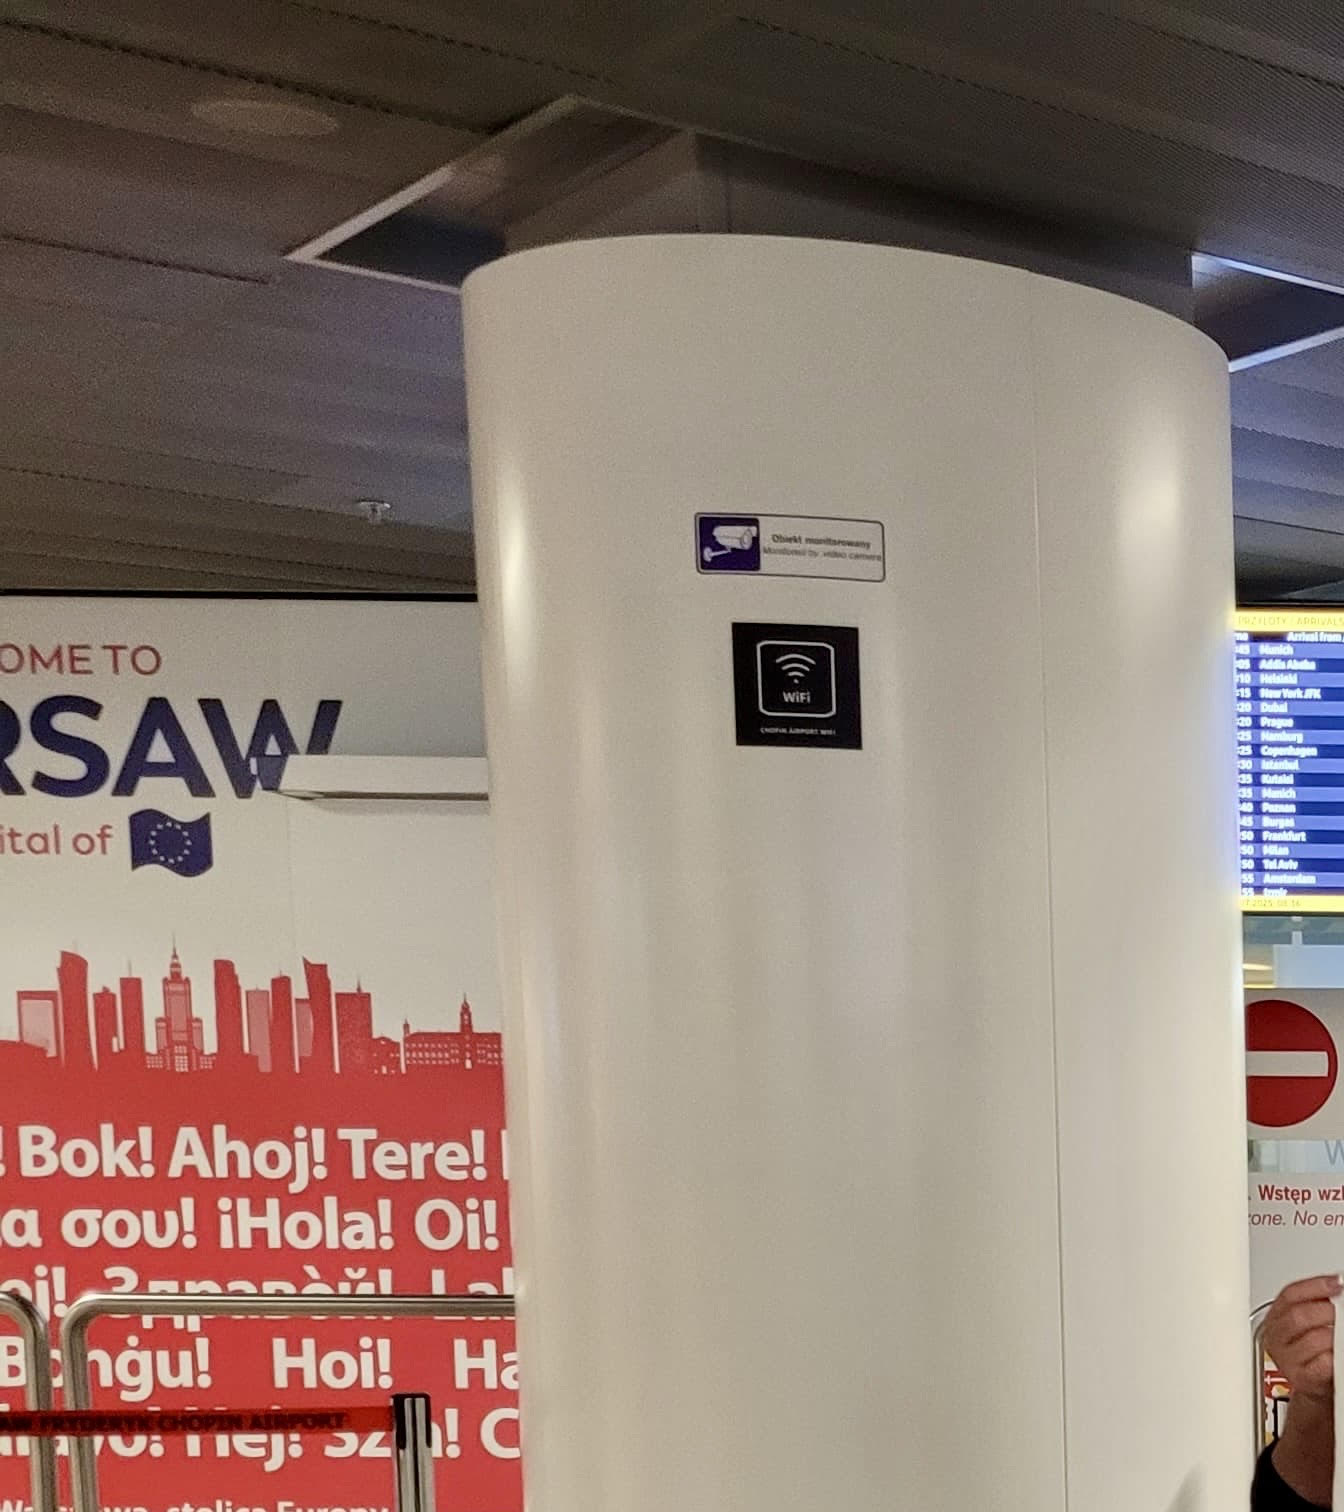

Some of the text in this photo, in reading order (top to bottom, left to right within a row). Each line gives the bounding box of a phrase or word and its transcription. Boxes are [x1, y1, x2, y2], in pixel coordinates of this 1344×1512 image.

[102, 645, 162, 676] TO
[783, 691, 811, 703] WiFi
[73, 824, 113, 856] of
[18, 1124, 488, 1194] Bok! Ahoj! Tere!
[1258, 1184, 1312, 1205] Wstęp
[61, 1197, 197, 1249] σου!
[217, 1196, 500, 1250] ¡Hola! Oi!
[1249, 1212, 1286, 1226] one.
[1293, 1210, 1318, 1226] No
[272, 1336, 394, 1390] Hoi!
